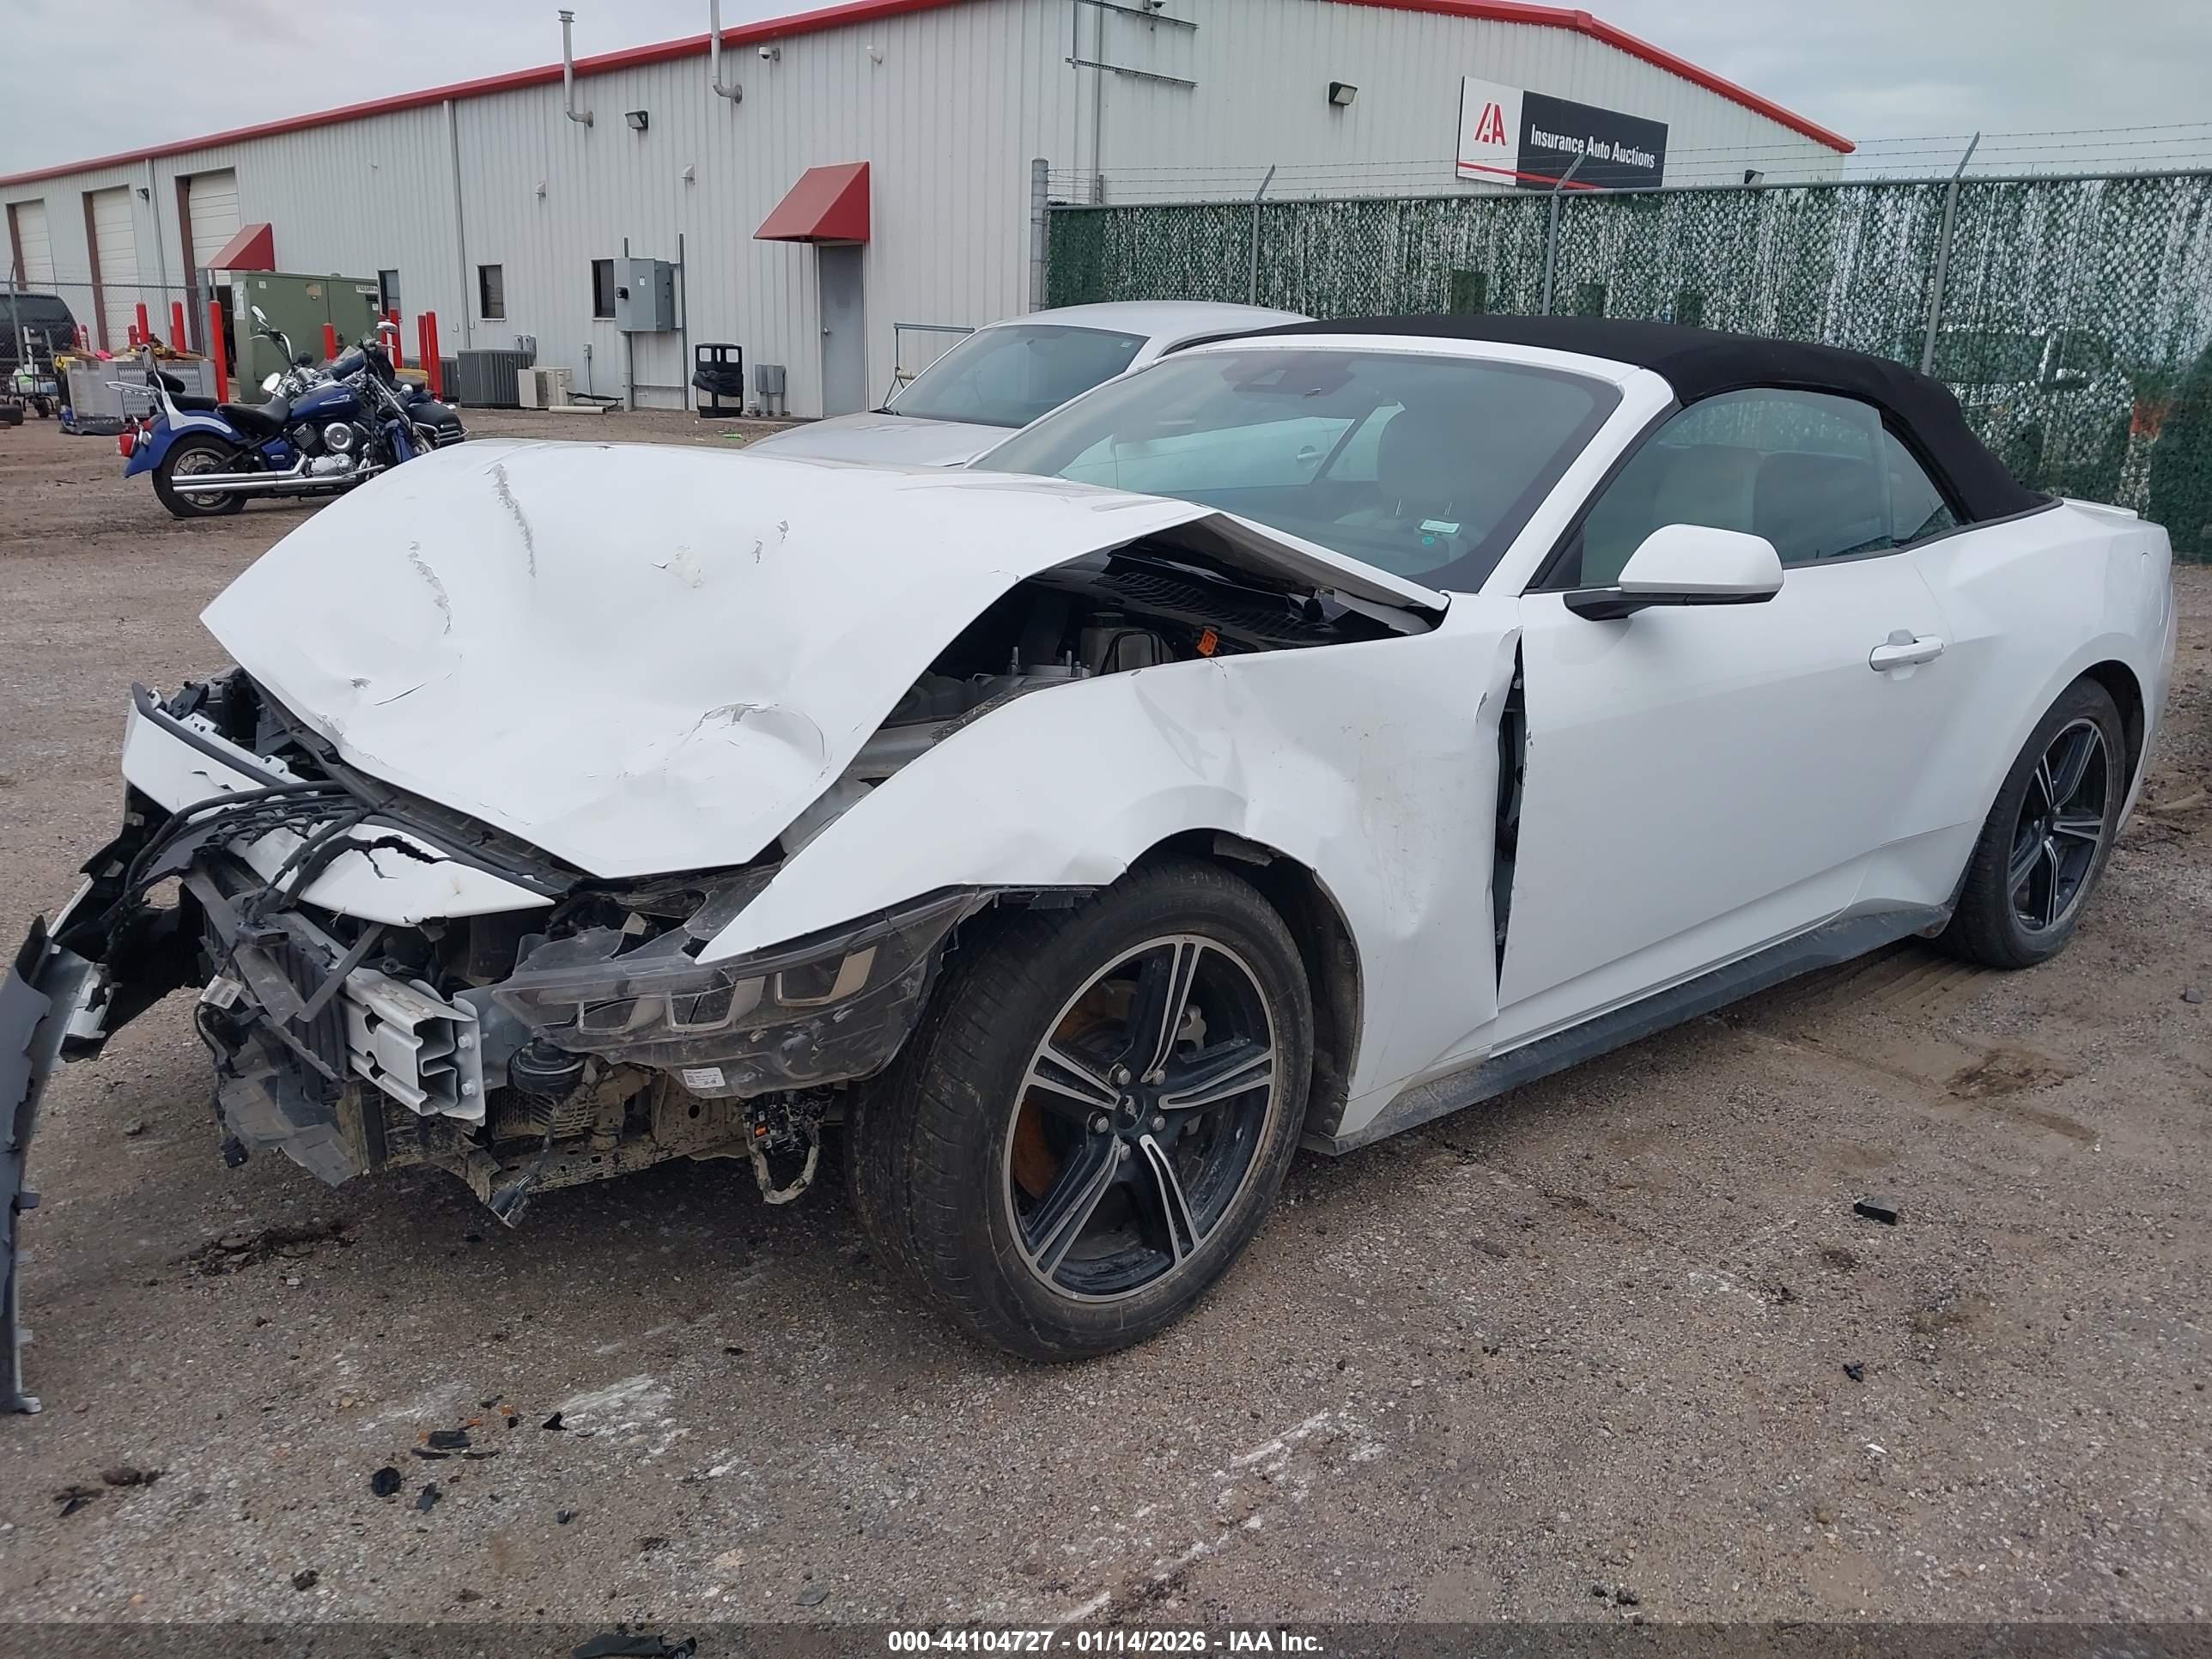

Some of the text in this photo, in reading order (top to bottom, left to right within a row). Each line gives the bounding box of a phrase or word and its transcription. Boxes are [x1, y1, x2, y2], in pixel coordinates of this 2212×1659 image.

[1530, 123, 1656, 169] Insurance Auto Auctions
